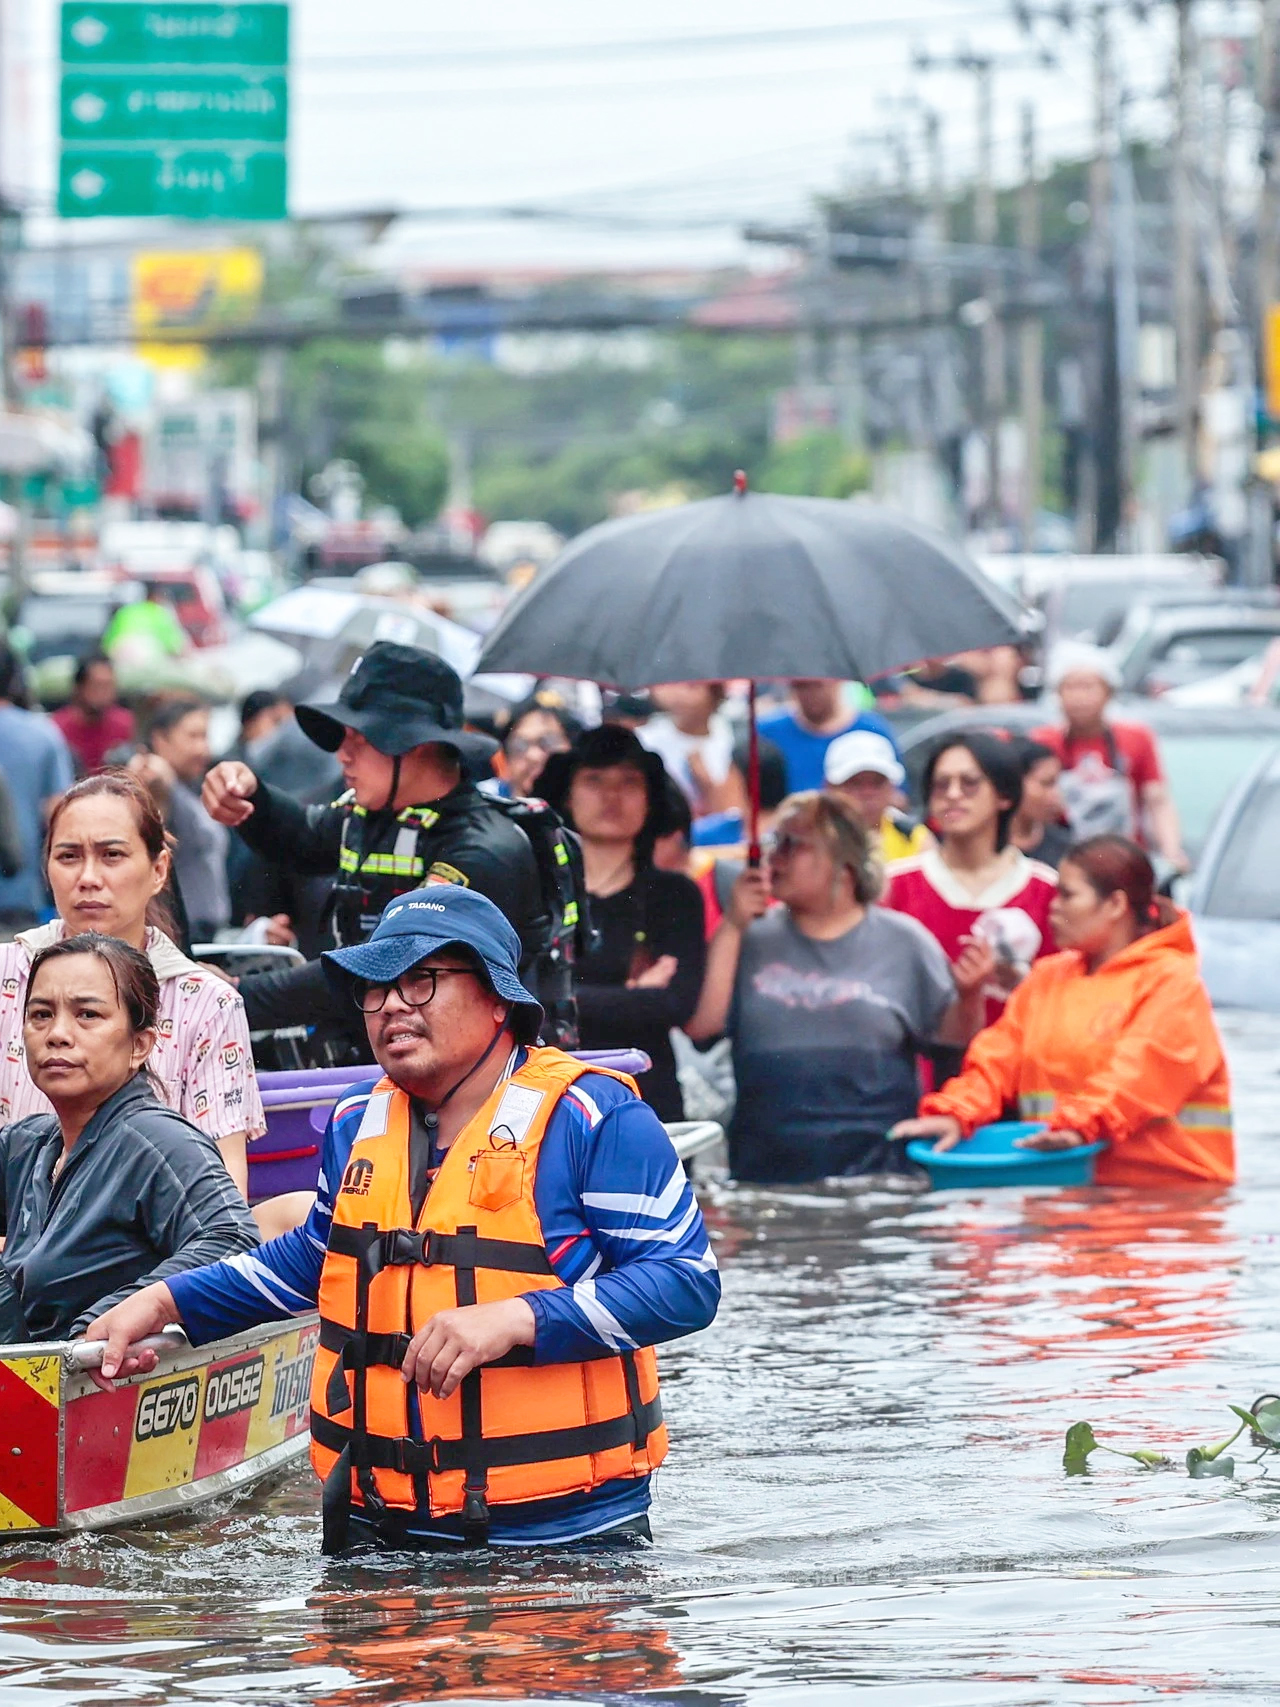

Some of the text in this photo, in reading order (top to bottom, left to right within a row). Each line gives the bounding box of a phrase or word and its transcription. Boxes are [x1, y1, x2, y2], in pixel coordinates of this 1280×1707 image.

[408, 902, 446, 913] TADANO
[136, 1359, 264, 1440] 6670 00562
